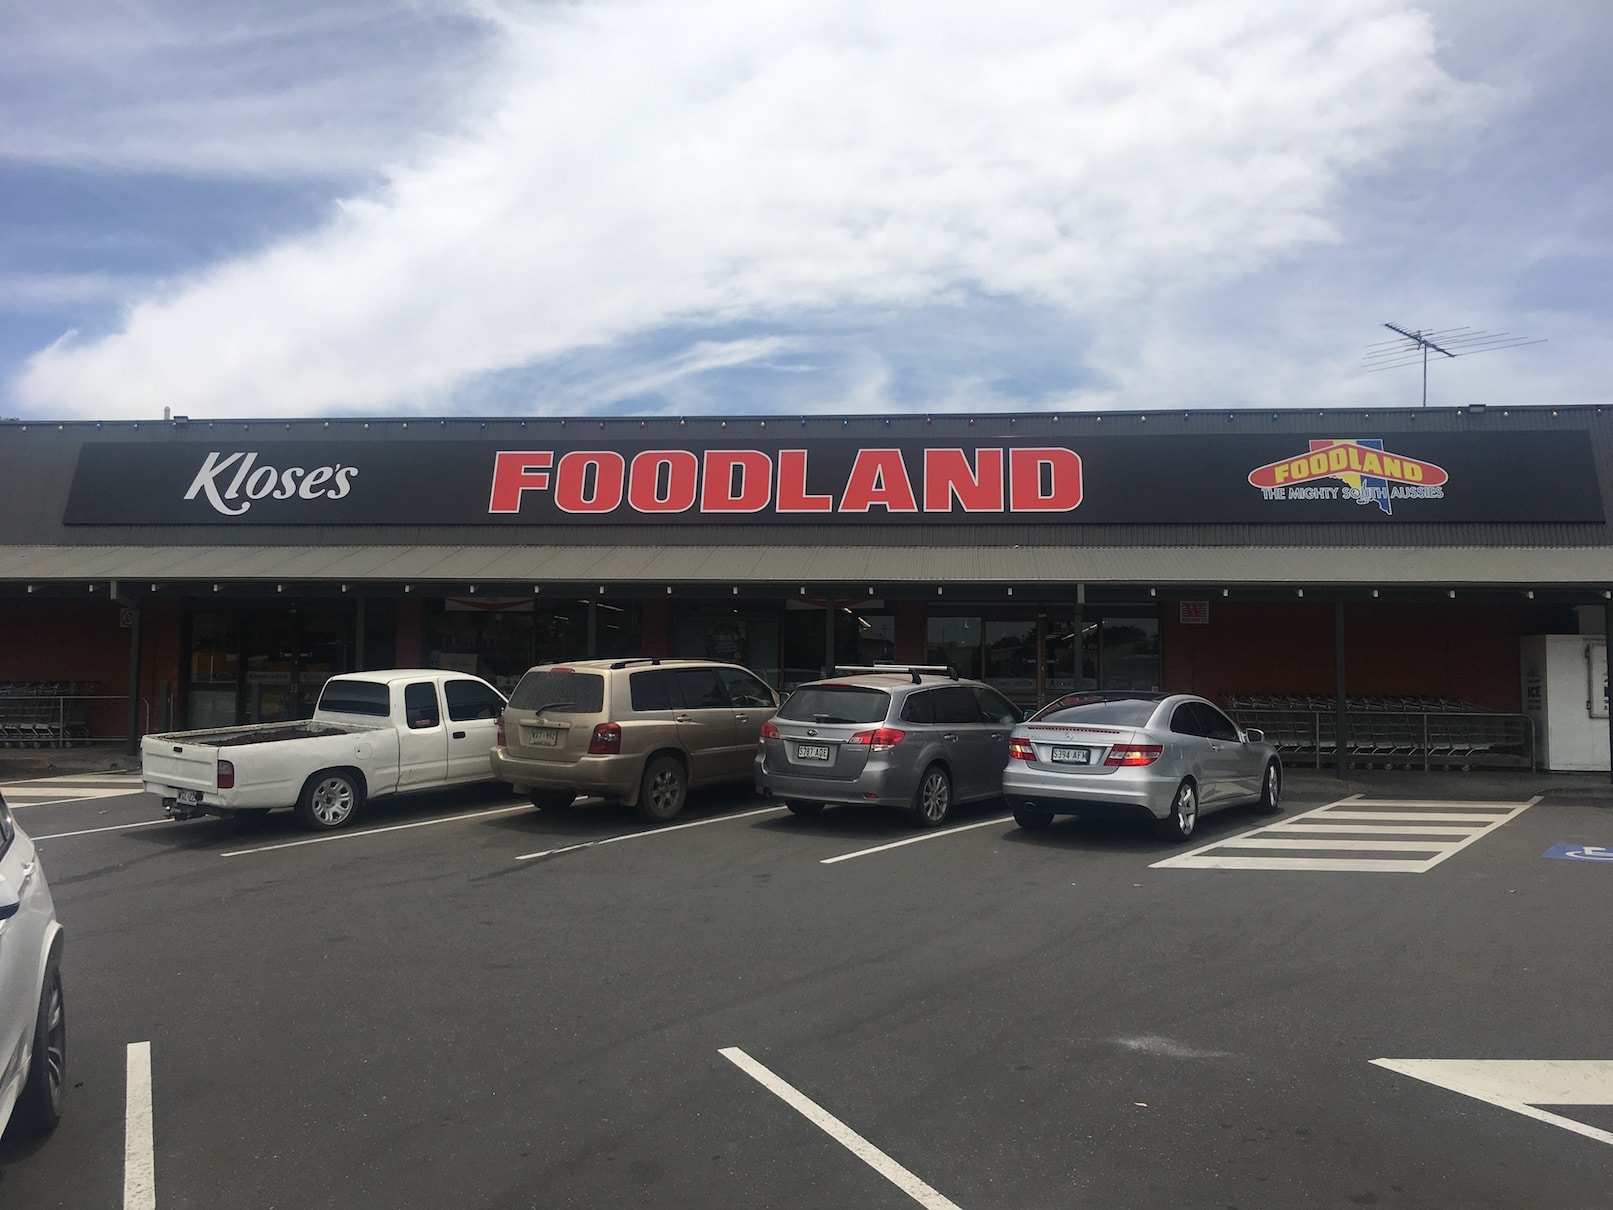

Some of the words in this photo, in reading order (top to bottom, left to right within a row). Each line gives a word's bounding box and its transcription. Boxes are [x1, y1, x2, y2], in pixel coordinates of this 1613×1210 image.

[489, 447, 1084, 514] FOODLAND
[1275, 448, 1423, 483] FOODLAND
[183, 452, 359, 515] Klose's
[1262, 487, 1287, 500] THE
[1289, 487, 1338, 500] MIGHTY
[1342, 487, 1387, 500] SOUTH
[1391, 487, 1444, 499] AUSSIES
[1527, 686, 1542, 698] ICE
